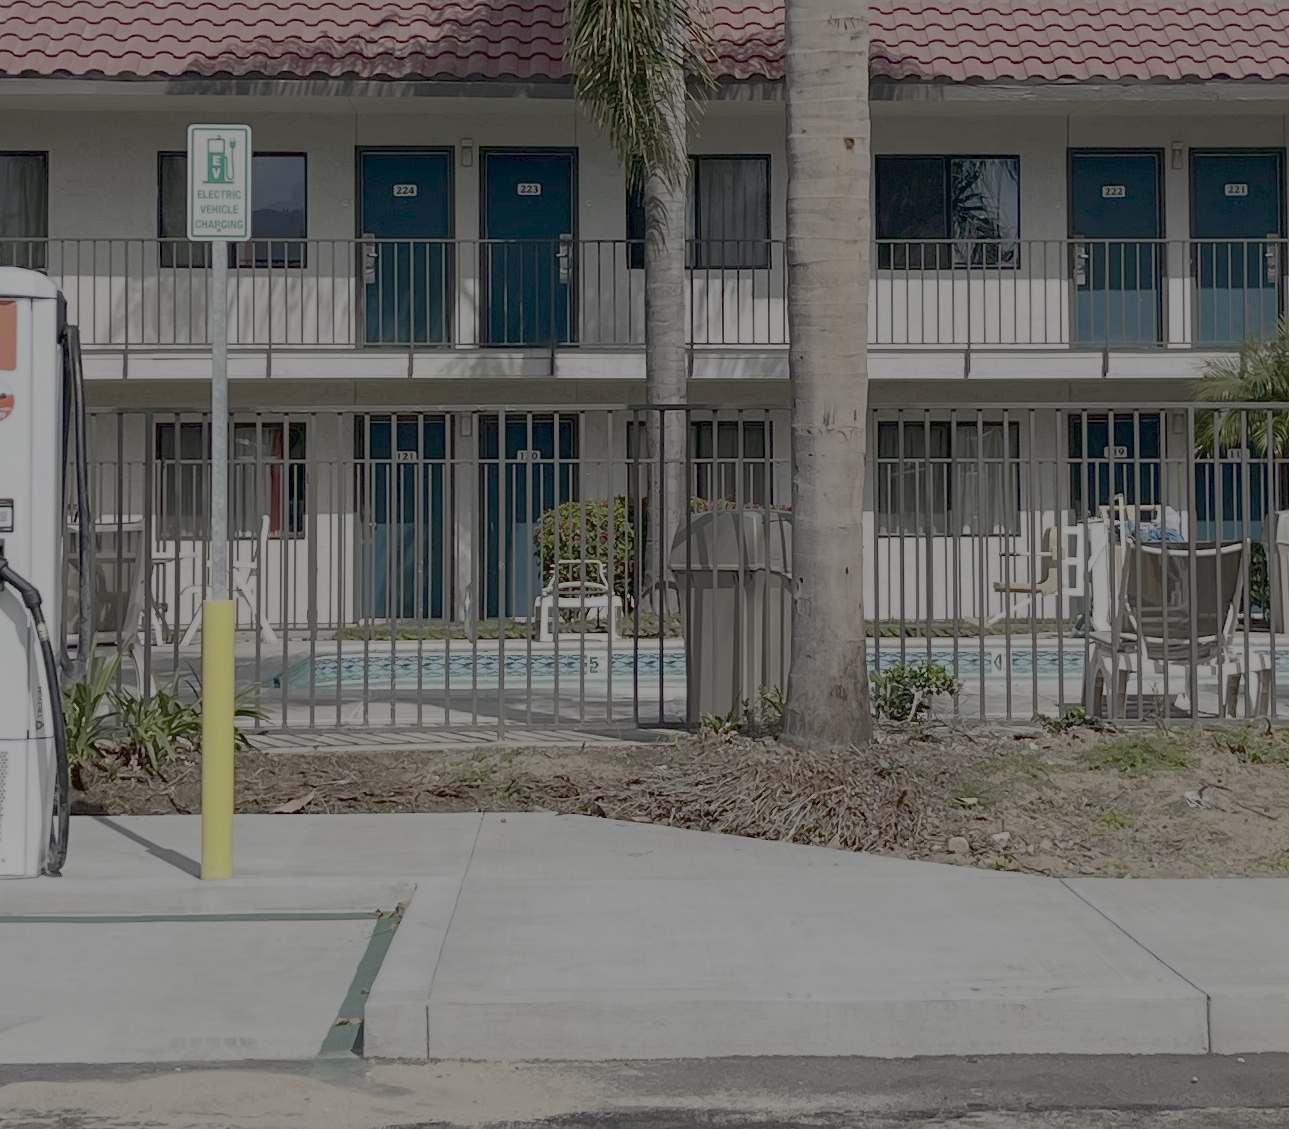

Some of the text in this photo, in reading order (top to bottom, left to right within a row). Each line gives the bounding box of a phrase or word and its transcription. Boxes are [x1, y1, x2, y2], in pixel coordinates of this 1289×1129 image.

[396, 187, 415, 195] 224
[520, 185, 539, 194] 223
[1105, 187, 1123, 196] 222
[1228, 185, 1245, 194] 221
[197, 190, 241, 199] ELECTRIC
[199, 205, 239, 214] VEHICLE
[195, 220, 244, 230] CHARGING
[397, 452, 413, 461] 121
[520, 452, 538, 461] 10
